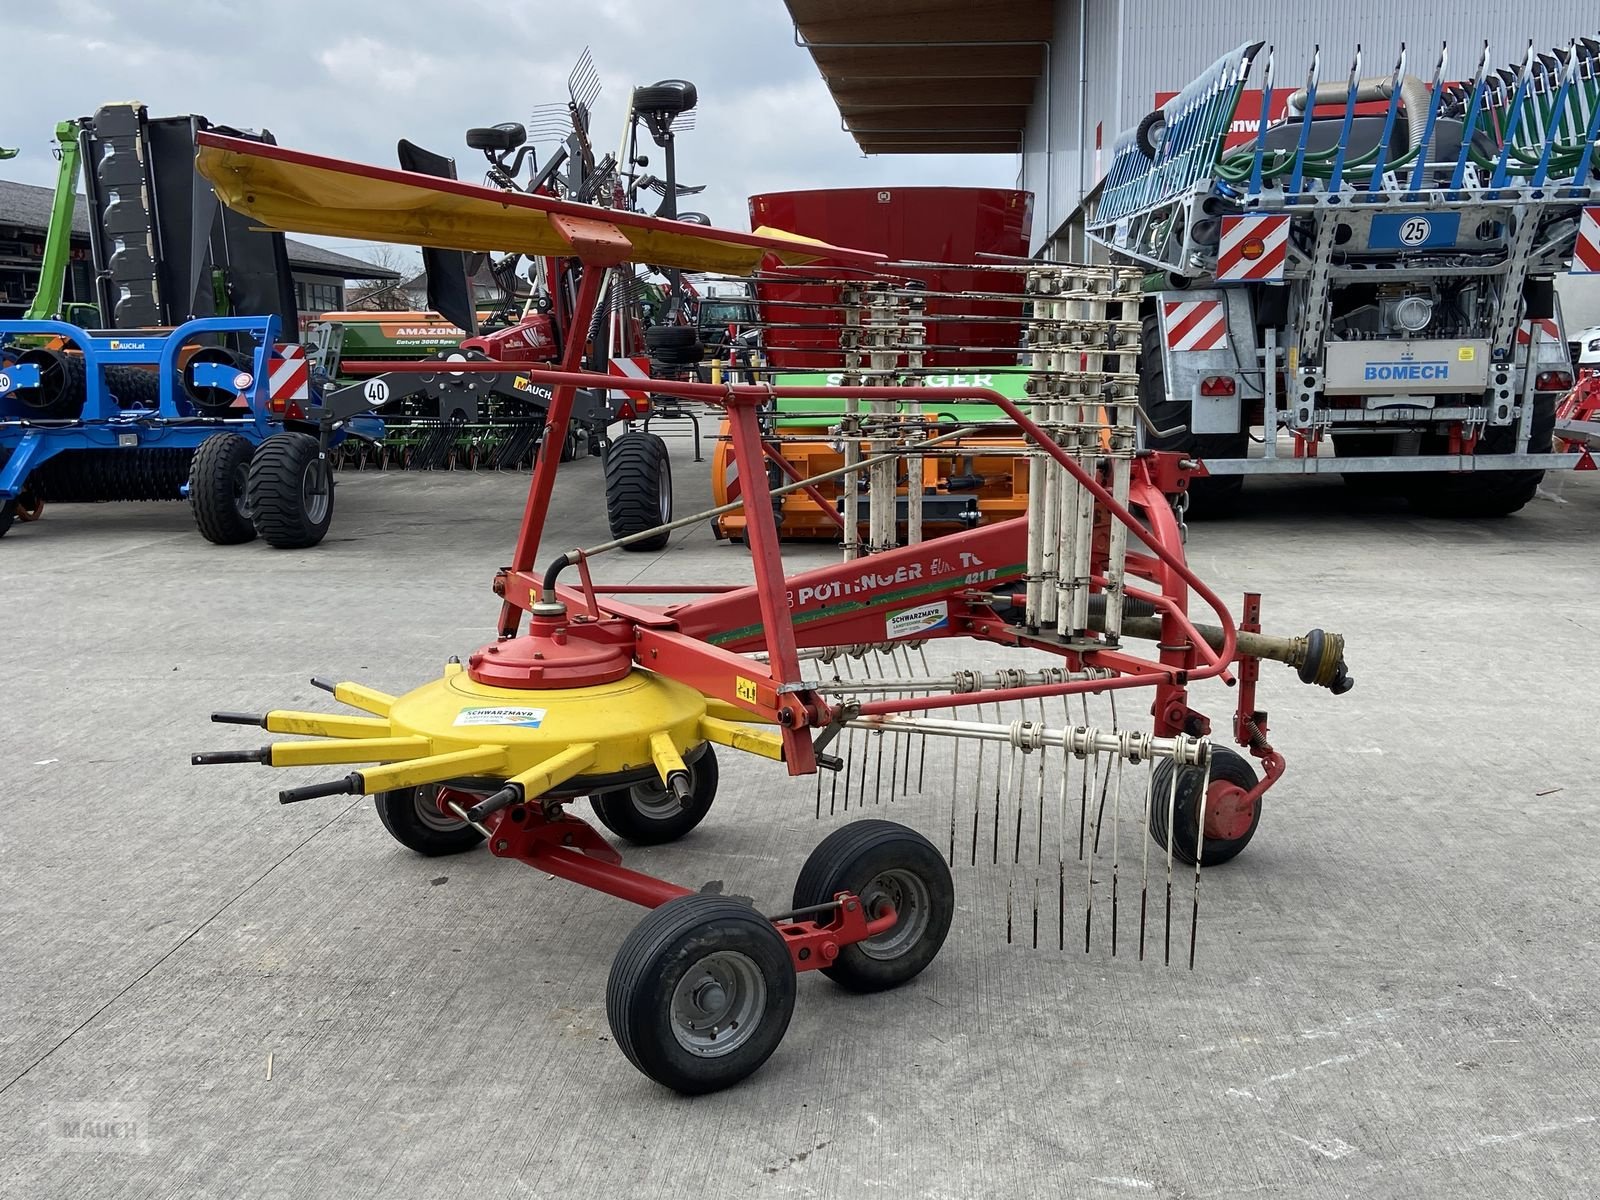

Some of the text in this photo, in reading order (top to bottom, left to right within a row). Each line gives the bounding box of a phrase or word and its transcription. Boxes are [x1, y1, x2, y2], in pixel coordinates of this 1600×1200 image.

[1405, 222, 1426, 241] 25
[396, 327, 466, 336] AMAZONE
[1365, 365, 1449, 380] BOMECH
[368, 383, 385, 401] 40
[964, 571, 985, 585] 421
[891, 608, 940, 624] SCHWARZMAYR
